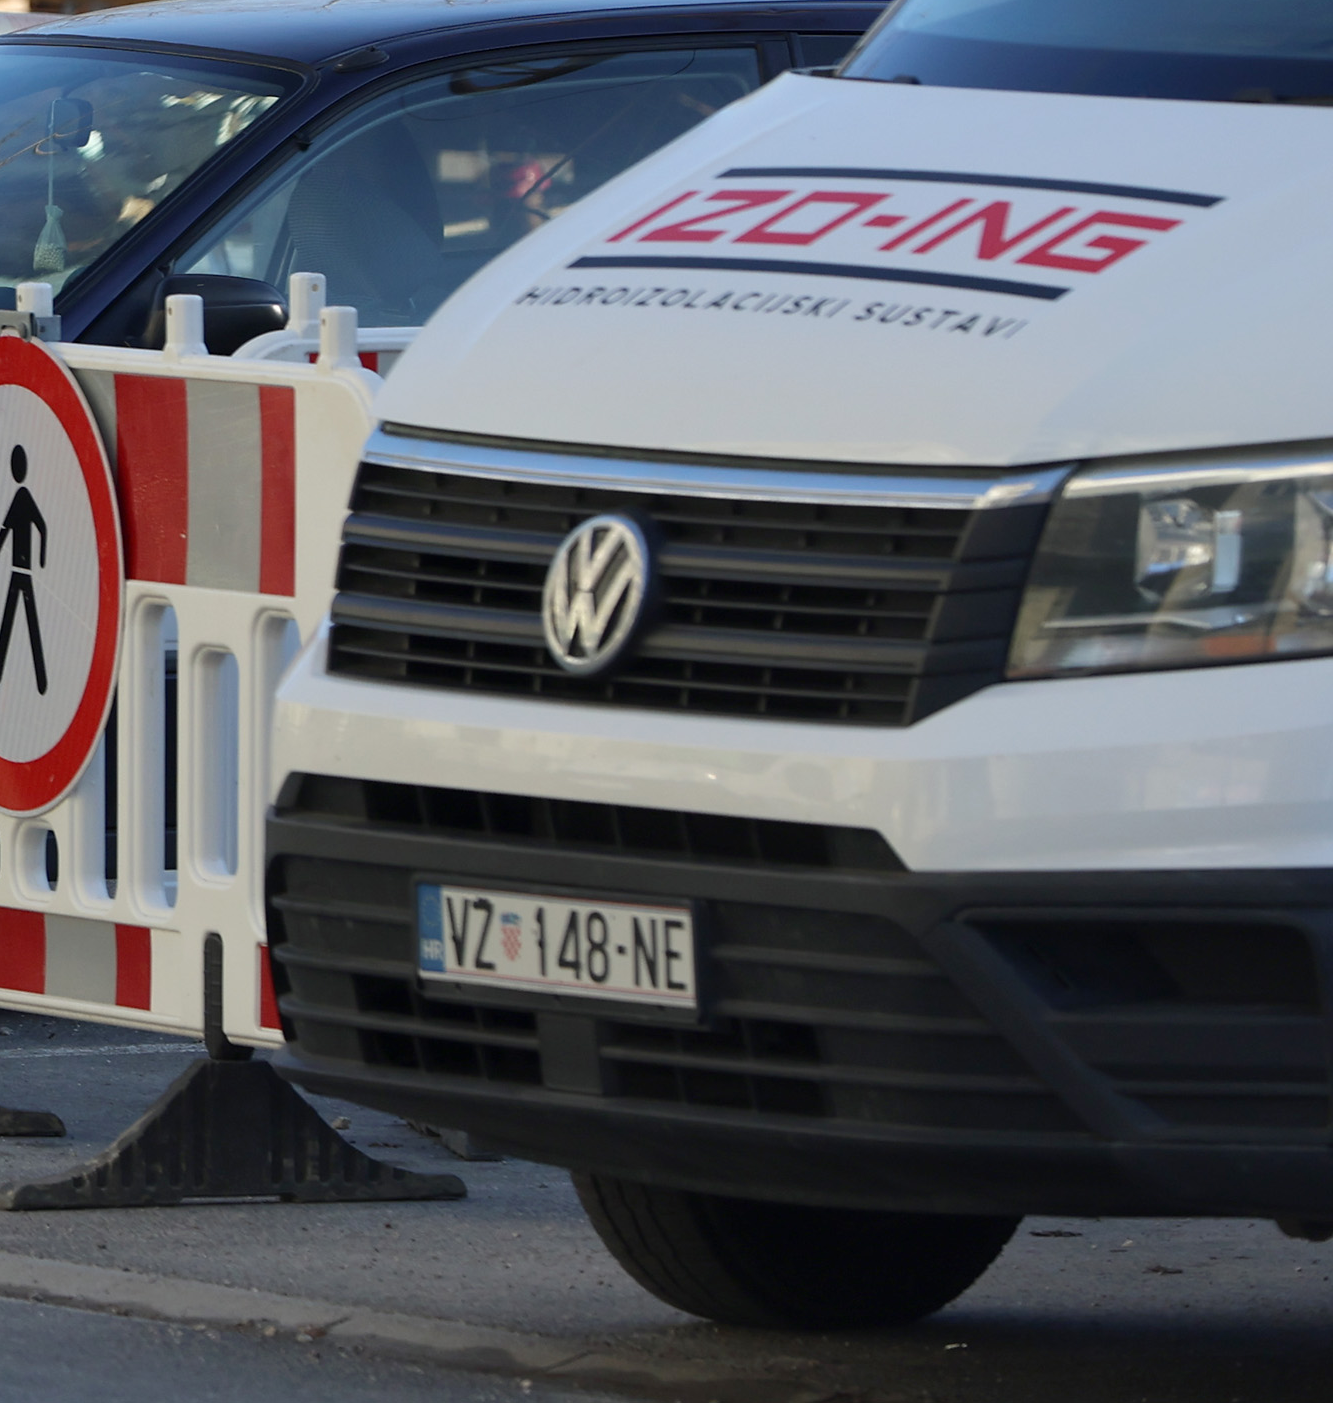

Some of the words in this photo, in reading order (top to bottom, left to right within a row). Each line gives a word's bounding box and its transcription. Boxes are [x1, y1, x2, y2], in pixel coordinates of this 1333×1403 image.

[605, 189, 1185, 275] IZO-ING
[515, 284, 854, 320] HIDROIZOLACIJSKI
[854, 298, 1030, 341] SUSTAVI
[420, 938, 444, 962] HR
